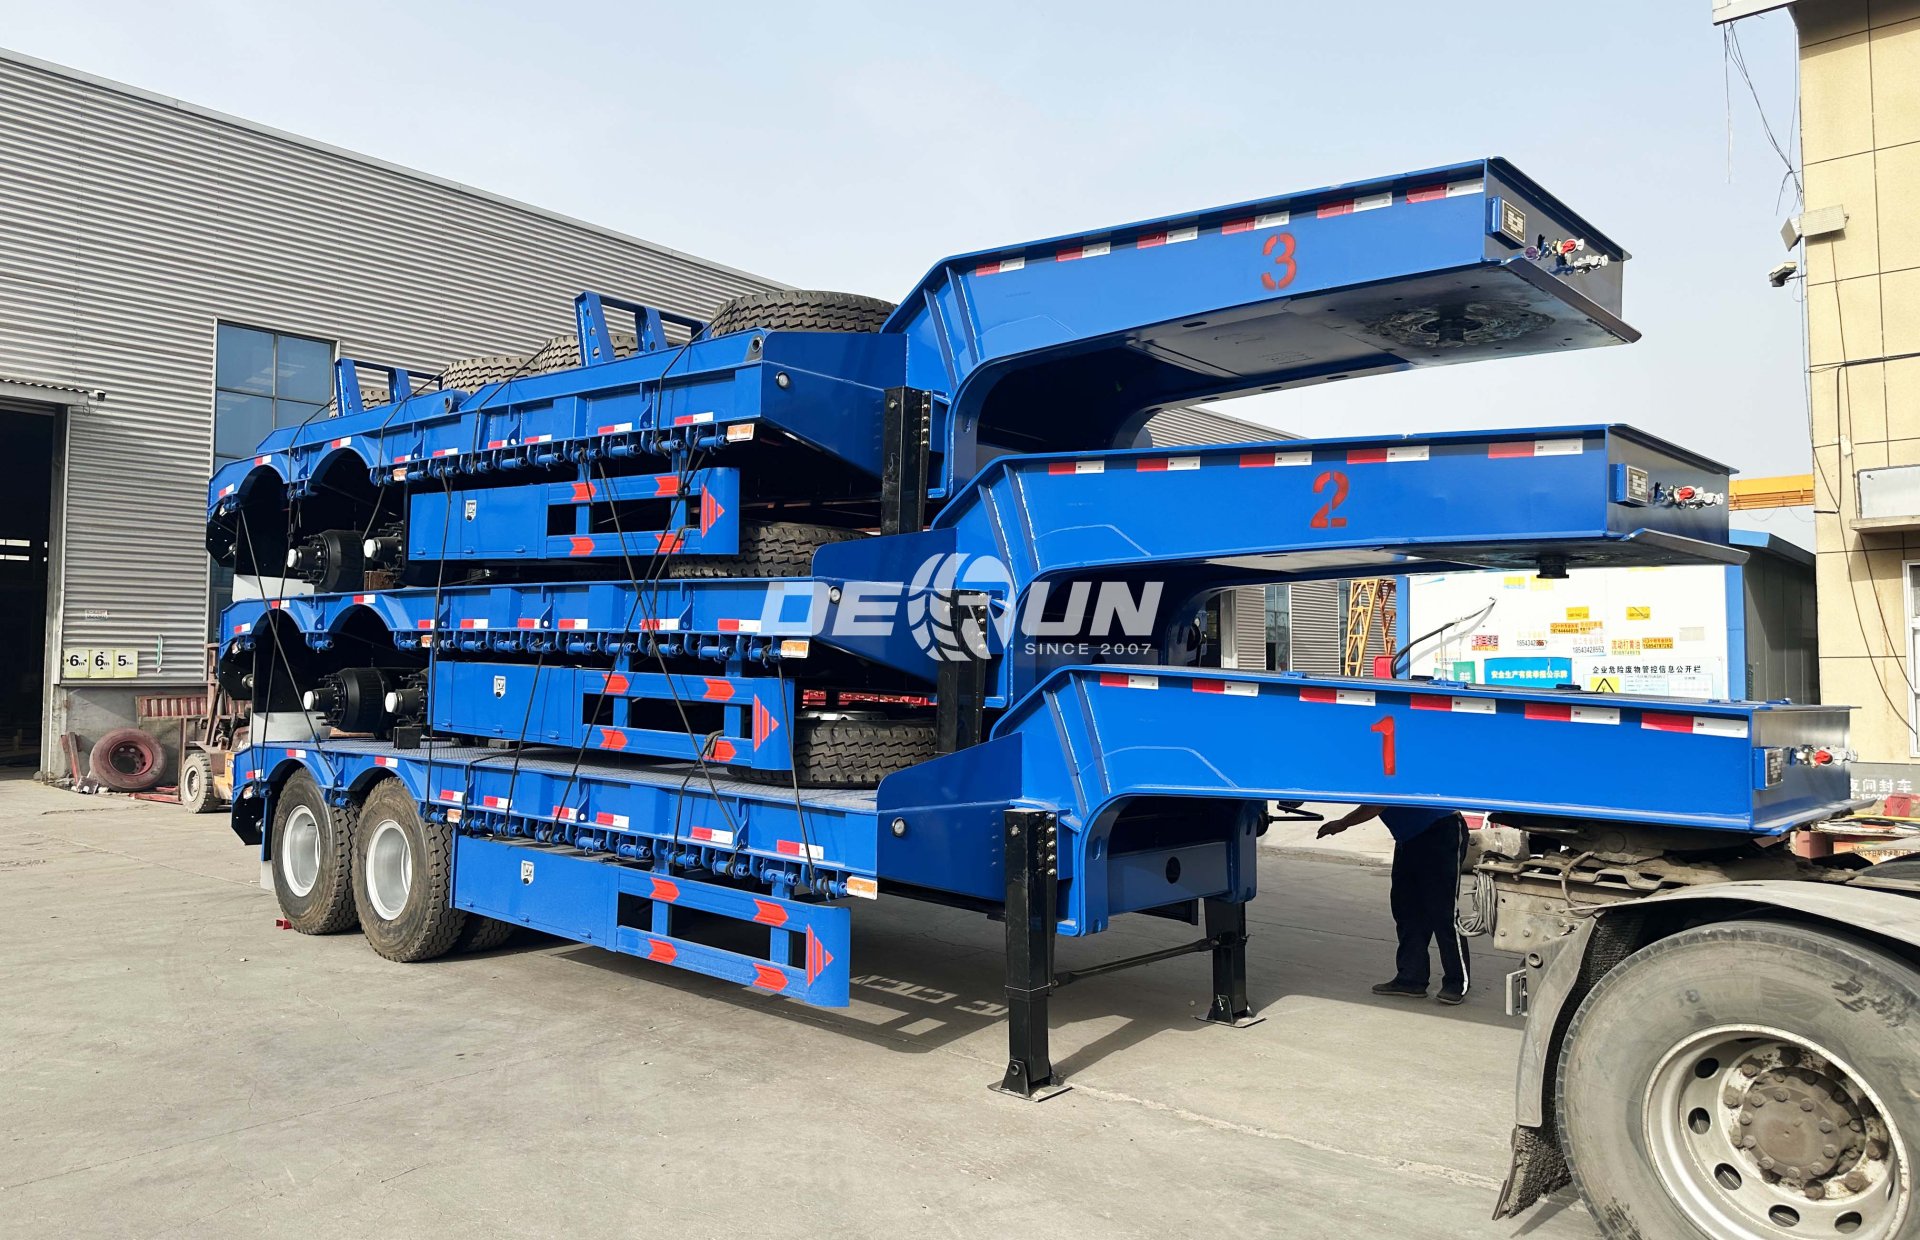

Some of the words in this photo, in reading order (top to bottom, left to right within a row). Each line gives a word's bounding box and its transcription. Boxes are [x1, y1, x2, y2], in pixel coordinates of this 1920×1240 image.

[1261, 233, 1297, 290] 3
[1310, 471, 1350, 528] 2
[1592, 665, 1701, 674] 企业危险废物管控信息公开栏
[1370, 715, 1396, 776] 1
